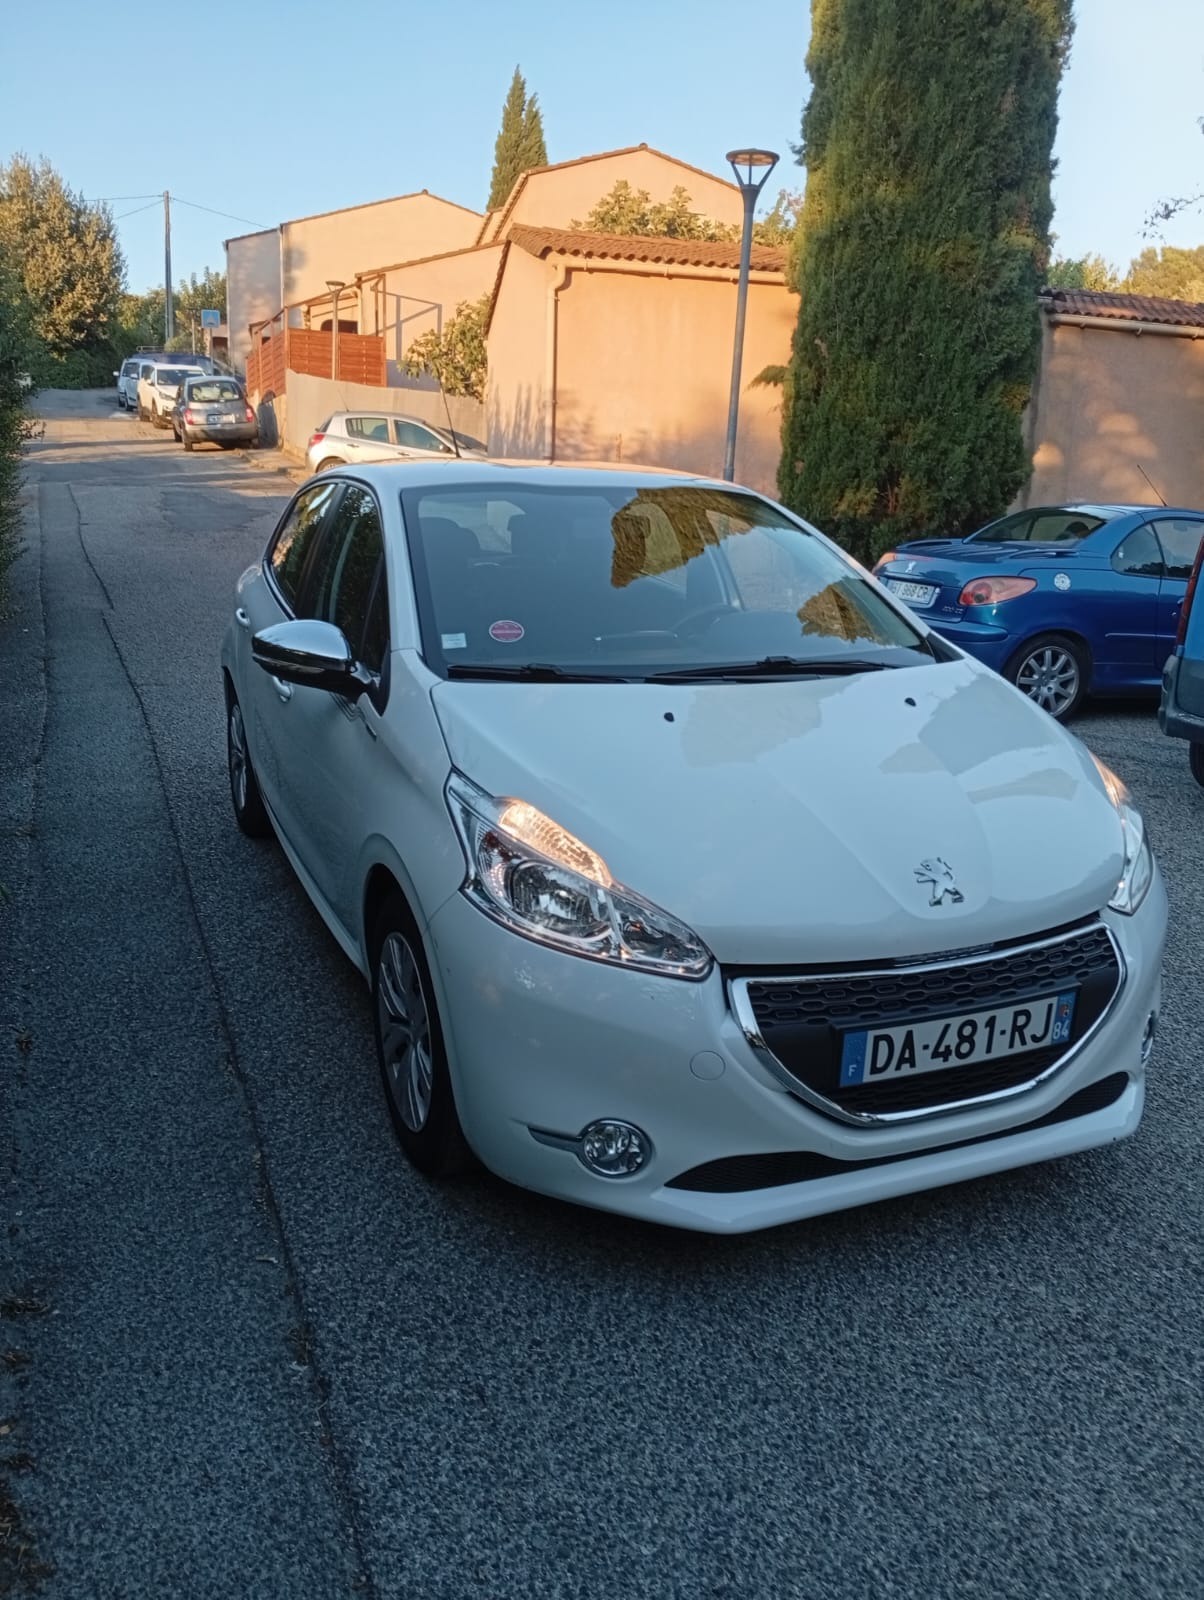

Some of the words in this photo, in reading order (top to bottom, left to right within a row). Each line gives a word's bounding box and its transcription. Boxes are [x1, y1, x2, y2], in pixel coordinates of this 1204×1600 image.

[869, 1003, 1053, 1076] DA-481-RJ
[1053, 1021, 1070, 1040] 84
[848, 1064, 857, 1077] F
